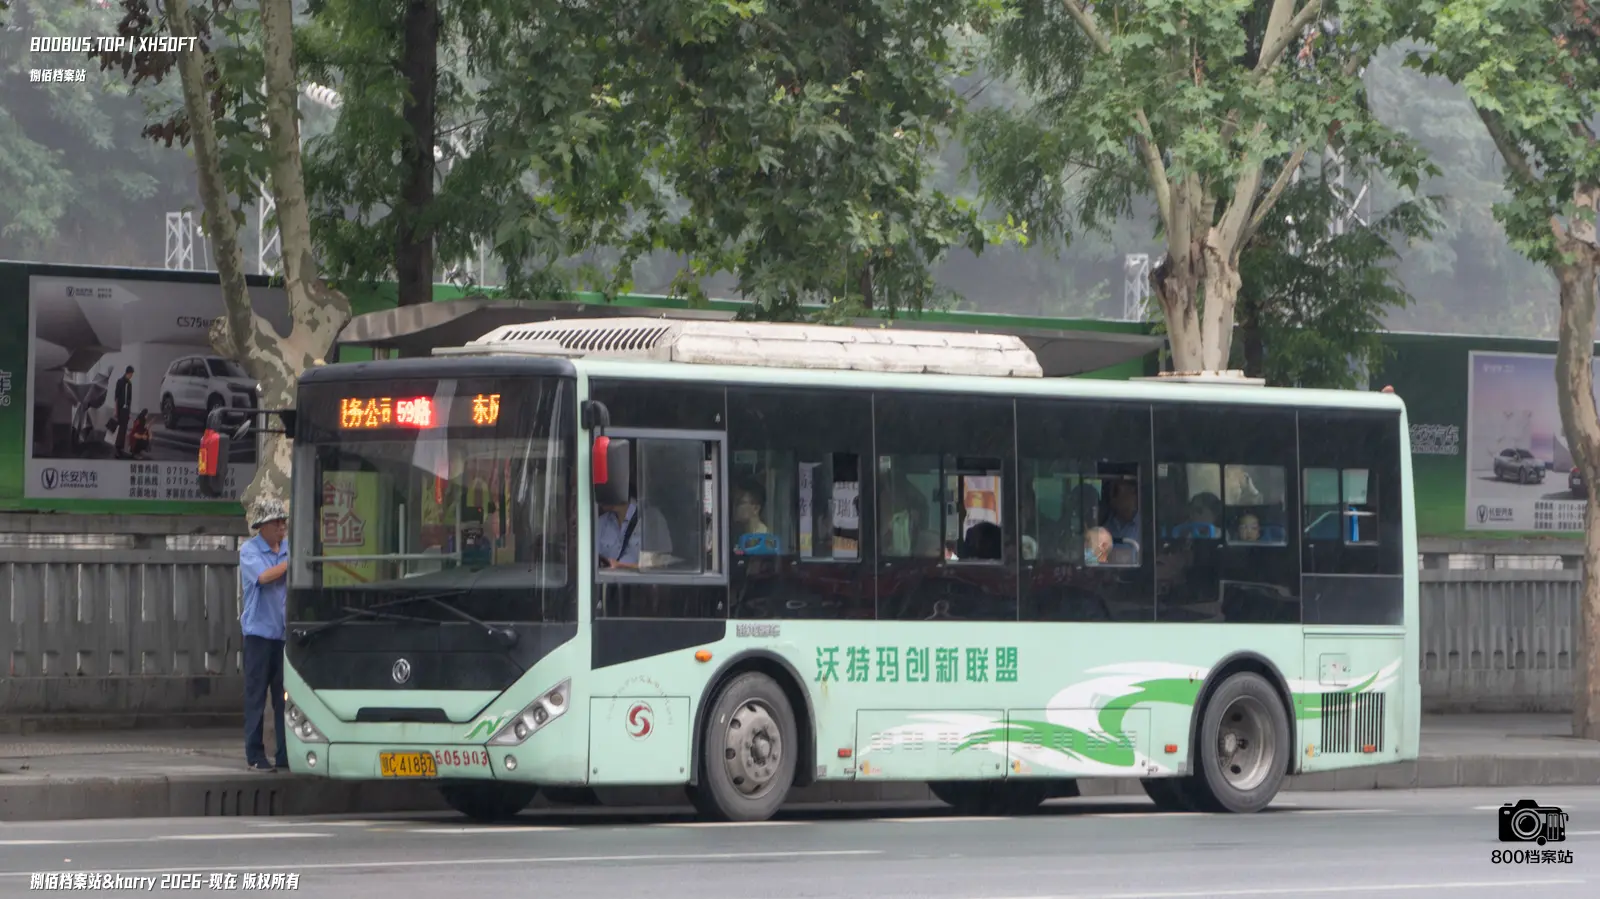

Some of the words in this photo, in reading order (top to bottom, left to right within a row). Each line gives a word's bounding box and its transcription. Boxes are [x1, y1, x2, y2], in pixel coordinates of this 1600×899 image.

[396, 397, 431, 426] 59路
[60, 470, 98, 483] 长安汽车
[814, 646, 1018, 683] 沃特玛创新联盟
[435, 750, 488, 767] 505903
